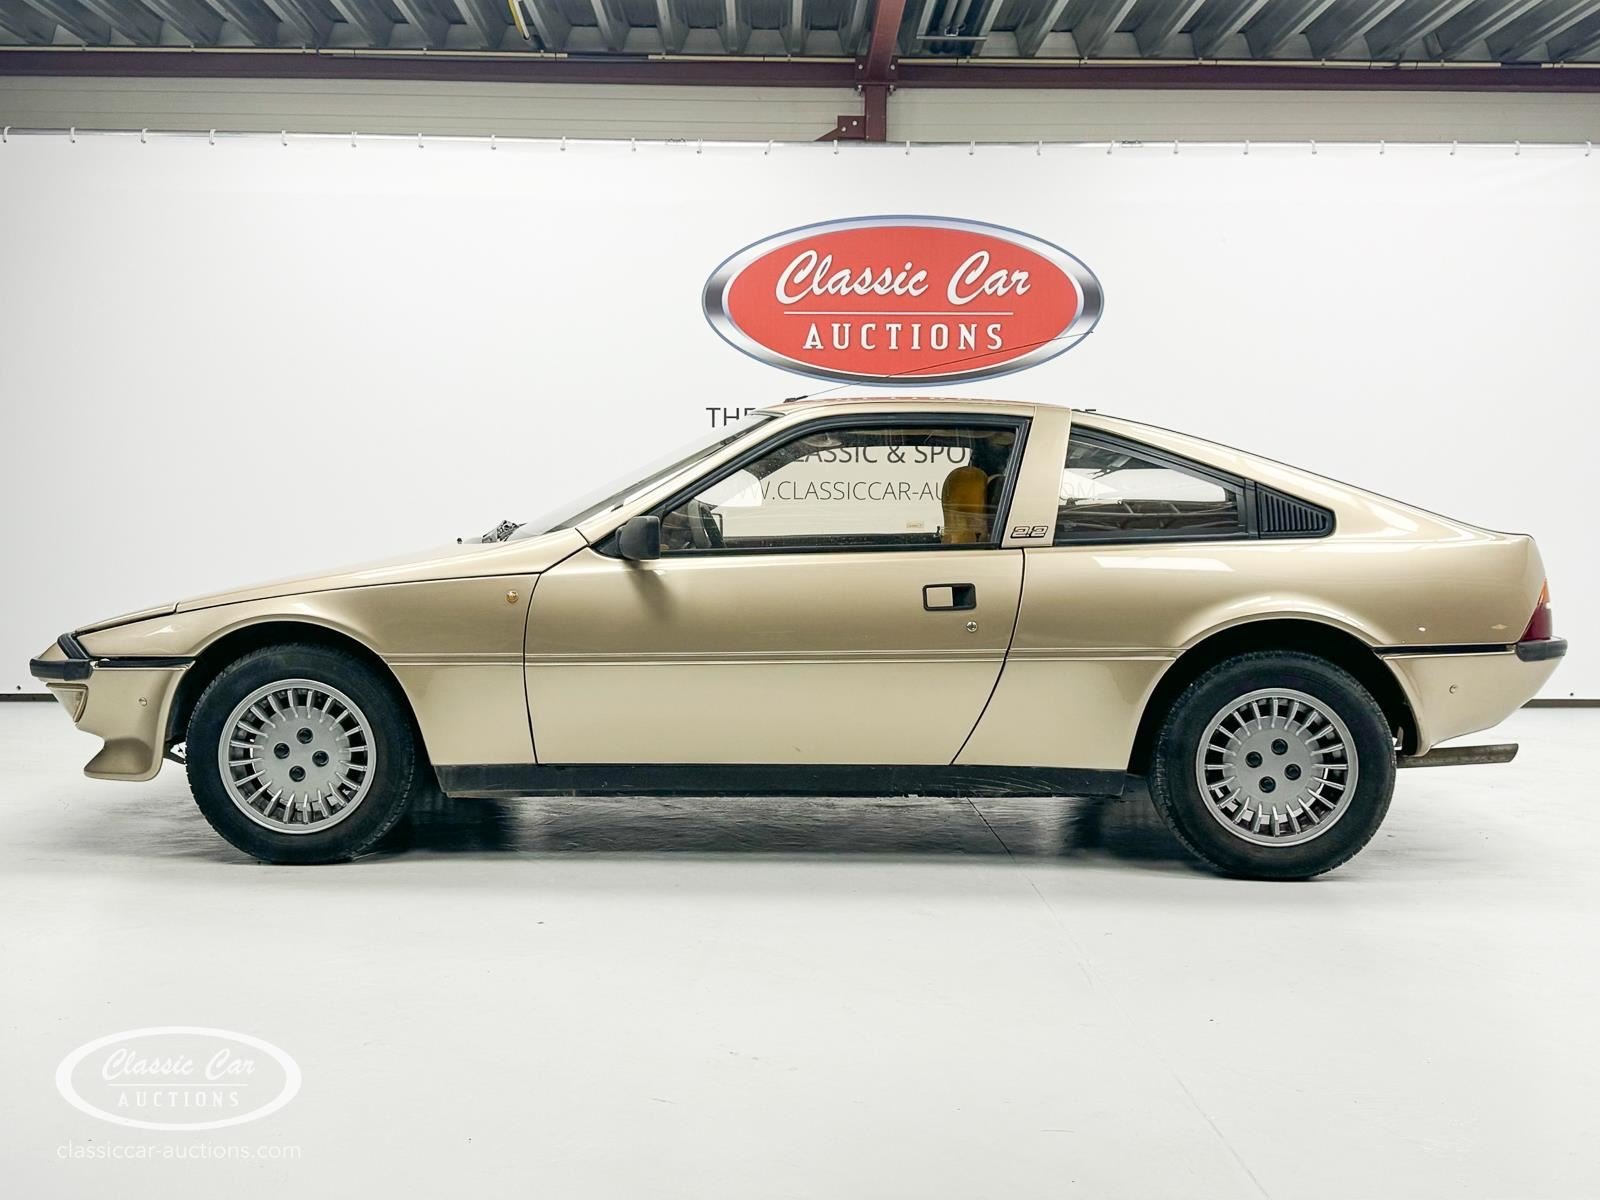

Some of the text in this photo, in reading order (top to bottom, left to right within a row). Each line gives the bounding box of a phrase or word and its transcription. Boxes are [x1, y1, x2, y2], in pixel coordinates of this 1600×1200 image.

[775, 249, 1032, 305] Classic Car
[802, 322, 1003, 351] AUCTIONS
[887, 446, 906, 463] &
[914, 446, 966, 463] SPO
